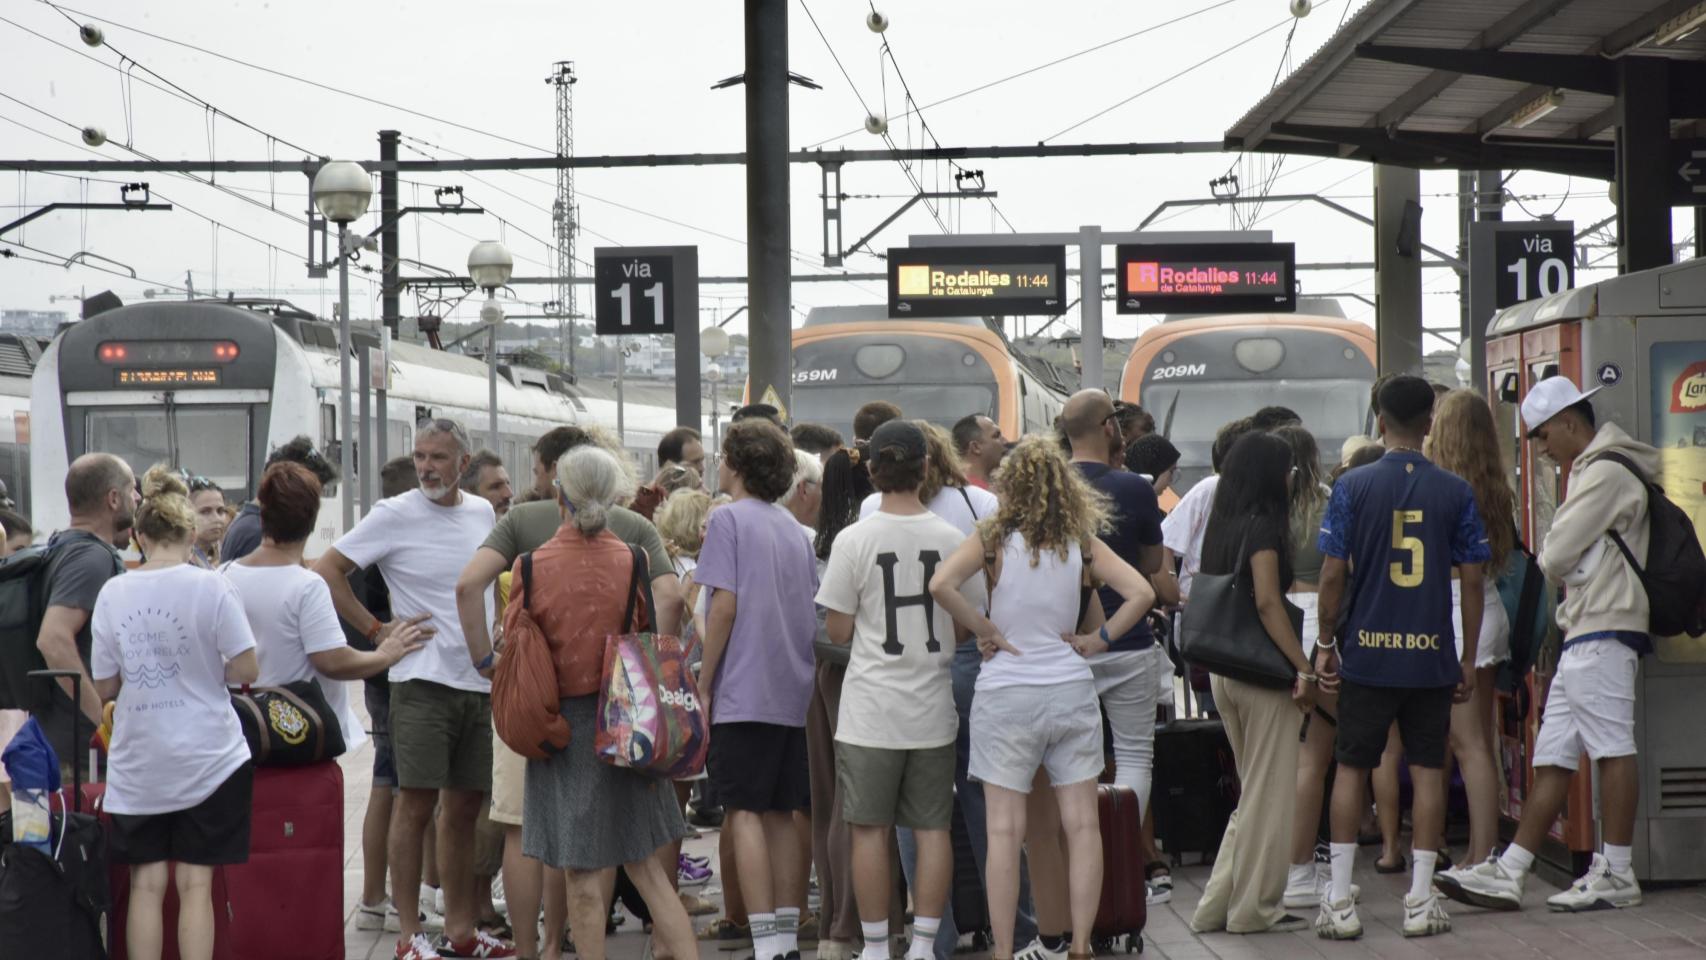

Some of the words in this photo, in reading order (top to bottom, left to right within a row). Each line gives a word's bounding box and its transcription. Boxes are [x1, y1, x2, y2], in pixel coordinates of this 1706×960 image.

[1523, 233, 1553, 253] via
[622, 259, 652, 278] via
[1139, 264, 1157, 283] R
[1160, 267, 1239, 284] Rodalies
[1245, 271, 1277, 285] 11:44
[931, 270, 1011, 287] Rodalies
[1016, 274, 1049, 288] 11:44
[1507, 257, 1569, 301] 10
[932, 286, 945, 296] de
[947, 286, 994, 297] Catalunya
[1160, 283, 1173, 293] de
[1175, 284, 1222, 295] Catalunya
[611, 282, 664, 326] 11
[1152, 363, 1207, 381] 209M
[1602, 366, 1617, 380] A
[1390, 510, 1425, 588] 5
[876, 550, 942, 656] H
[129, 631, 169, 645] COME,
[1358, 629, 1403, 649] SUPER
[154, 647, 191, 657] RELAX
[152, 699, 185, 710] HOTELS
